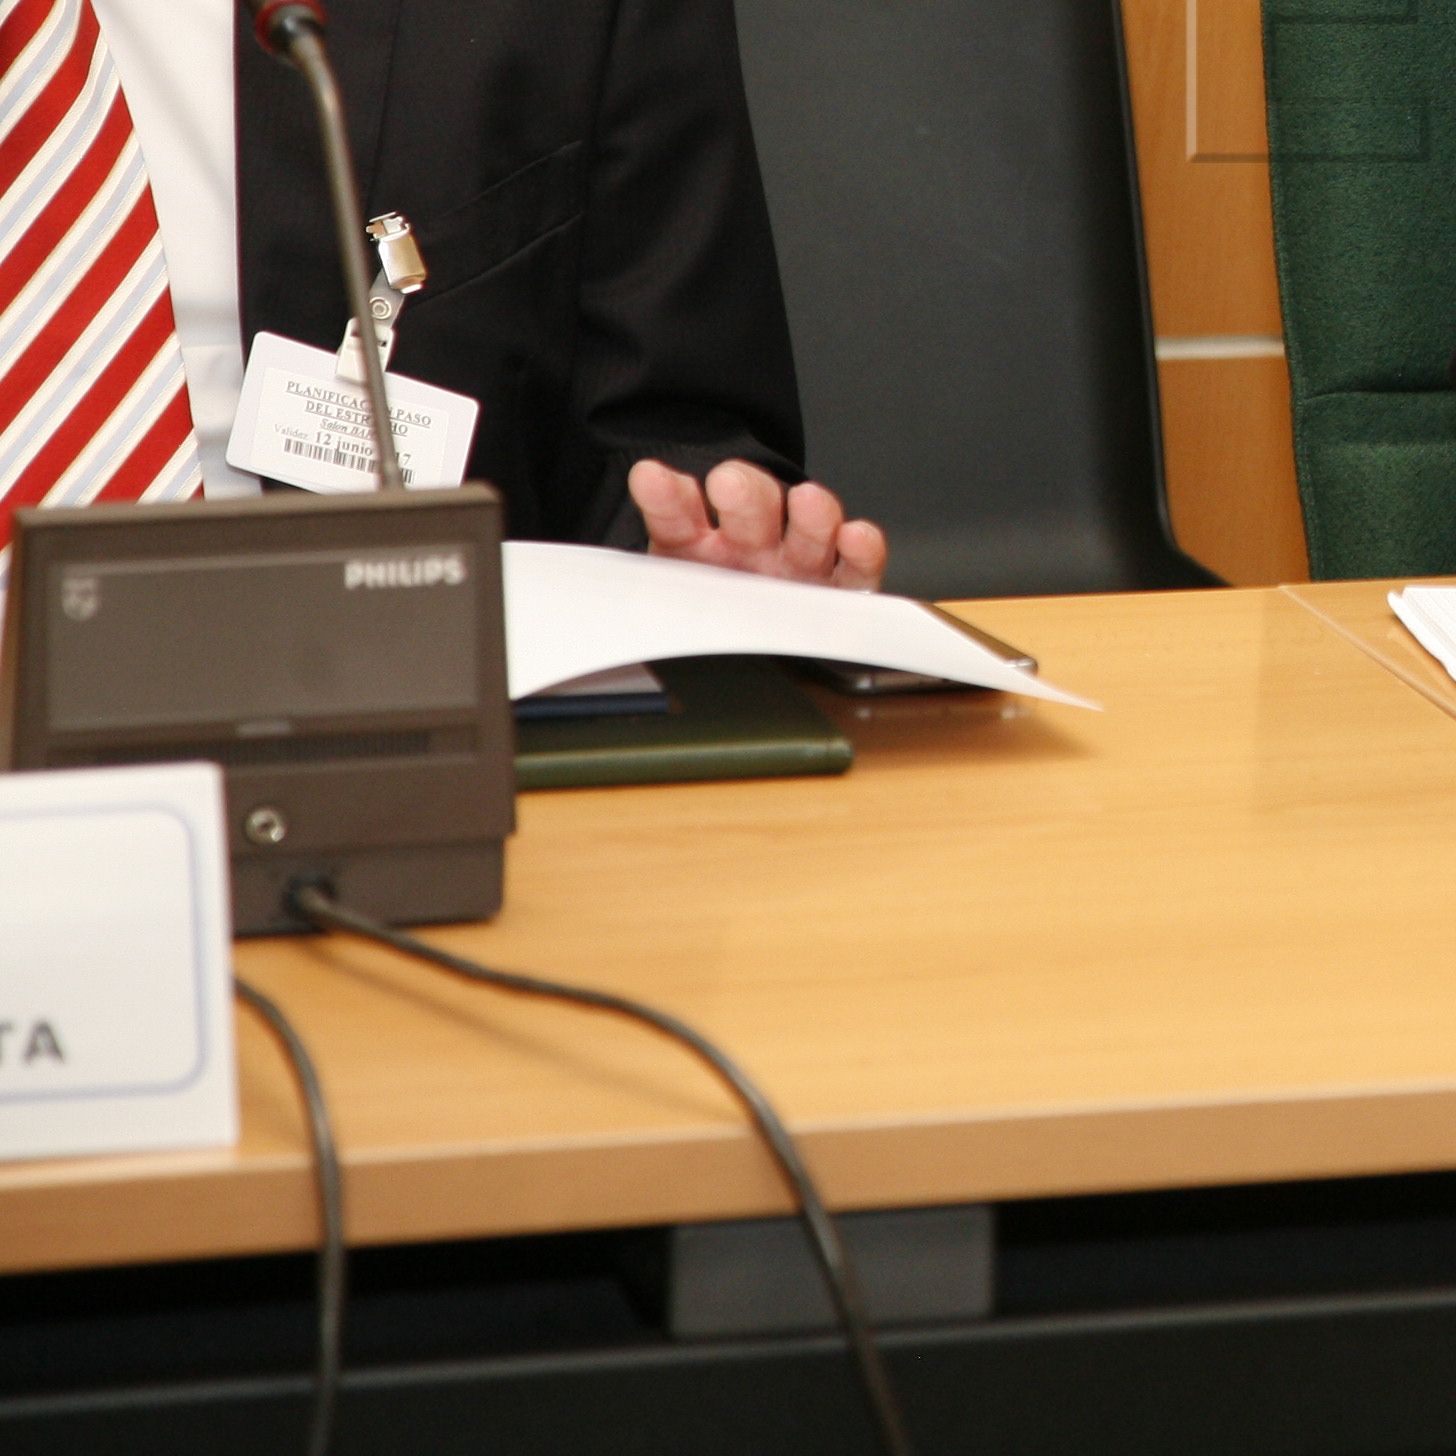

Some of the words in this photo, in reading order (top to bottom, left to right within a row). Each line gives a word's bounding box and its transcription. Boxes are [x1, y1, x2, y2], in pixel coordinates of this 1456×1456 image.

[285, 380, 395, 419] PLANIFICAC
[397, 409, 432, 427] PASO
[304, 399, 332, 417] DEL
[335, 407, 409, 435] ESTRHO
[314, 431, 332, 446] 12
[336, 436, 374, 457] junio
[344, 556, 466, 590] PHILIPS
